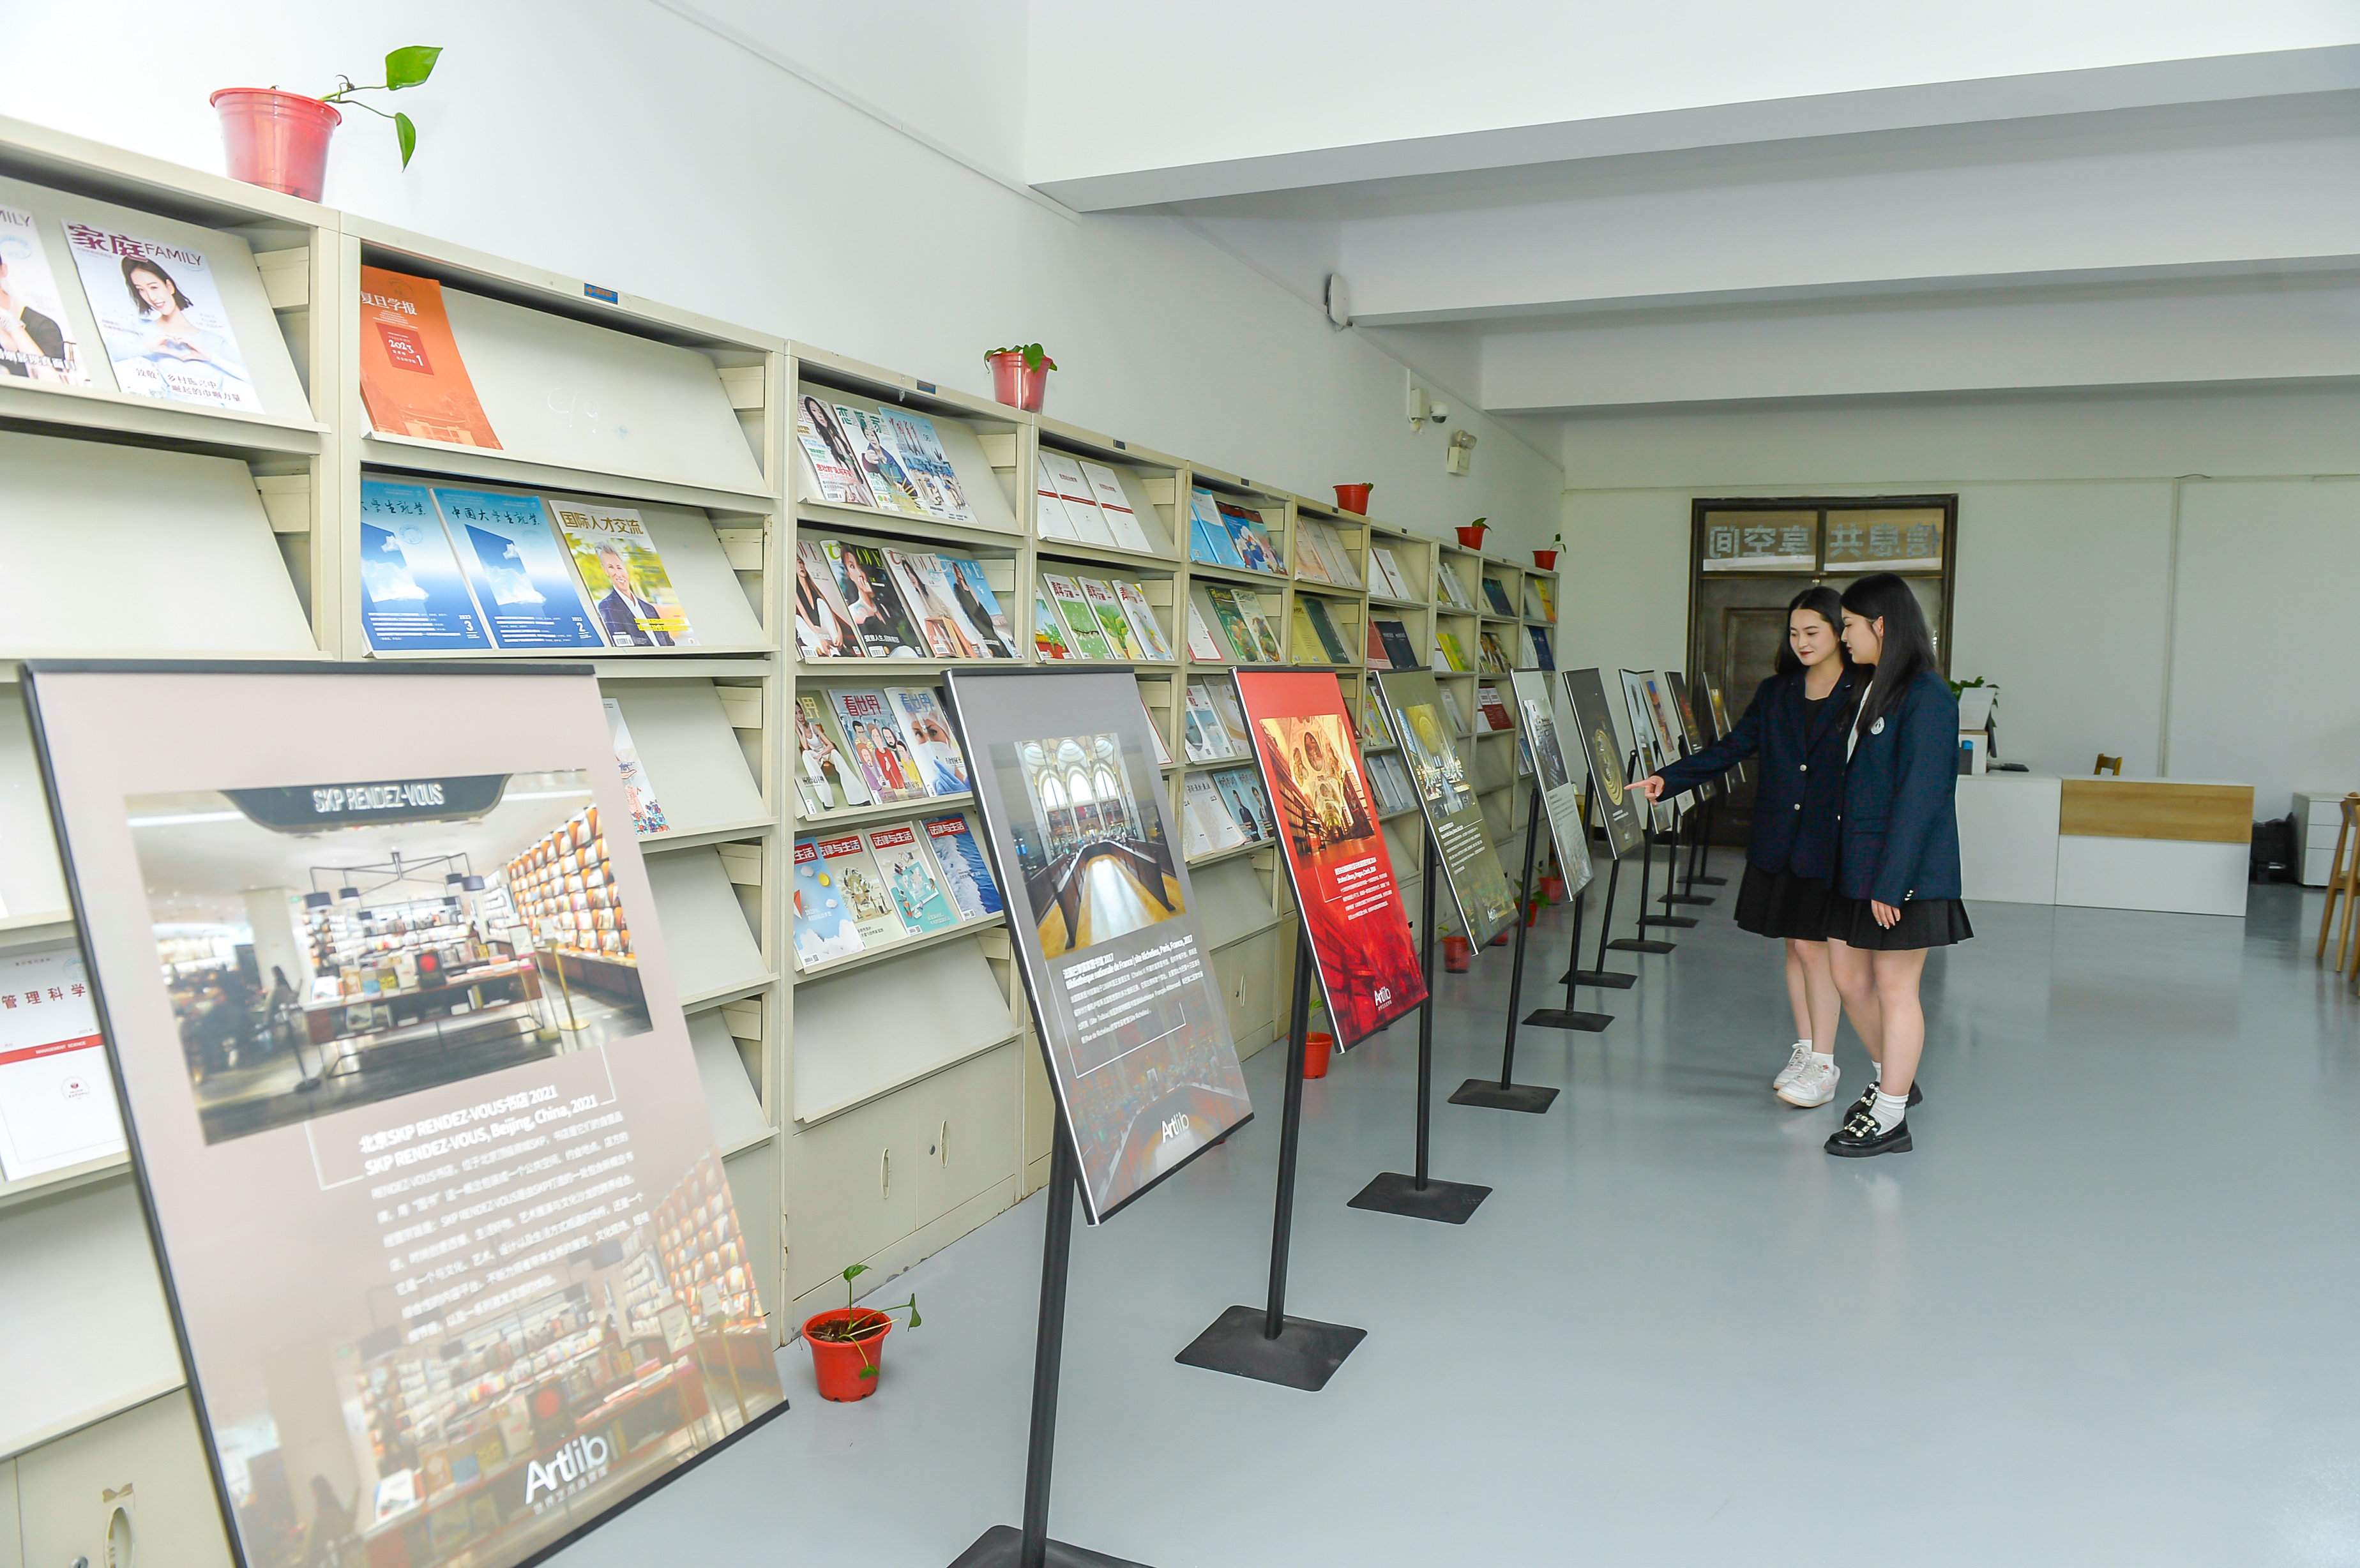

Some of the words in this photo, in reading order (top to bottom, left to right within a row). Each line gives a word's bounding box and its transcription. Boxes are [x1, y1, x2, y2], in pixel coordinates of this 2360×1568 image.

[67, 223, 148, 262] 家庭
[145, 243, 201, 266] FAMILY
[388, 340, 414, 354] 2023
[559, 511, 644, 534] 国际人才交流
[464, 621, 474, 631] 3
[577, 622, 586, 632] 2
[842, 695, 881, 716] 看世界
[898, 693, 934, 713] 看世界
[313, 789, 345, 813] SKP
[346, 784, 445, 811] RENDEZ-VOUS
[873, 831, 914, 847] 法律与生活
[928, 821, 965, 836] 法律与生活
[2, 983, 86, 1009] 管理科学
[530, 1085, 557, 1104] 2021
[364, 1156, 393, 1177] SKP
[394, 1127, 490, 1167] RENDEZ-VOUS,
[491, 1113, 535, 1138] Beijing,
[534, 1103, 571, 1124] China,
[571, 1094, 599, 1113] 2021
[1162, 1112, 1189, 1143] Artlib
[526, 1435, 608, 1505] Artlib
